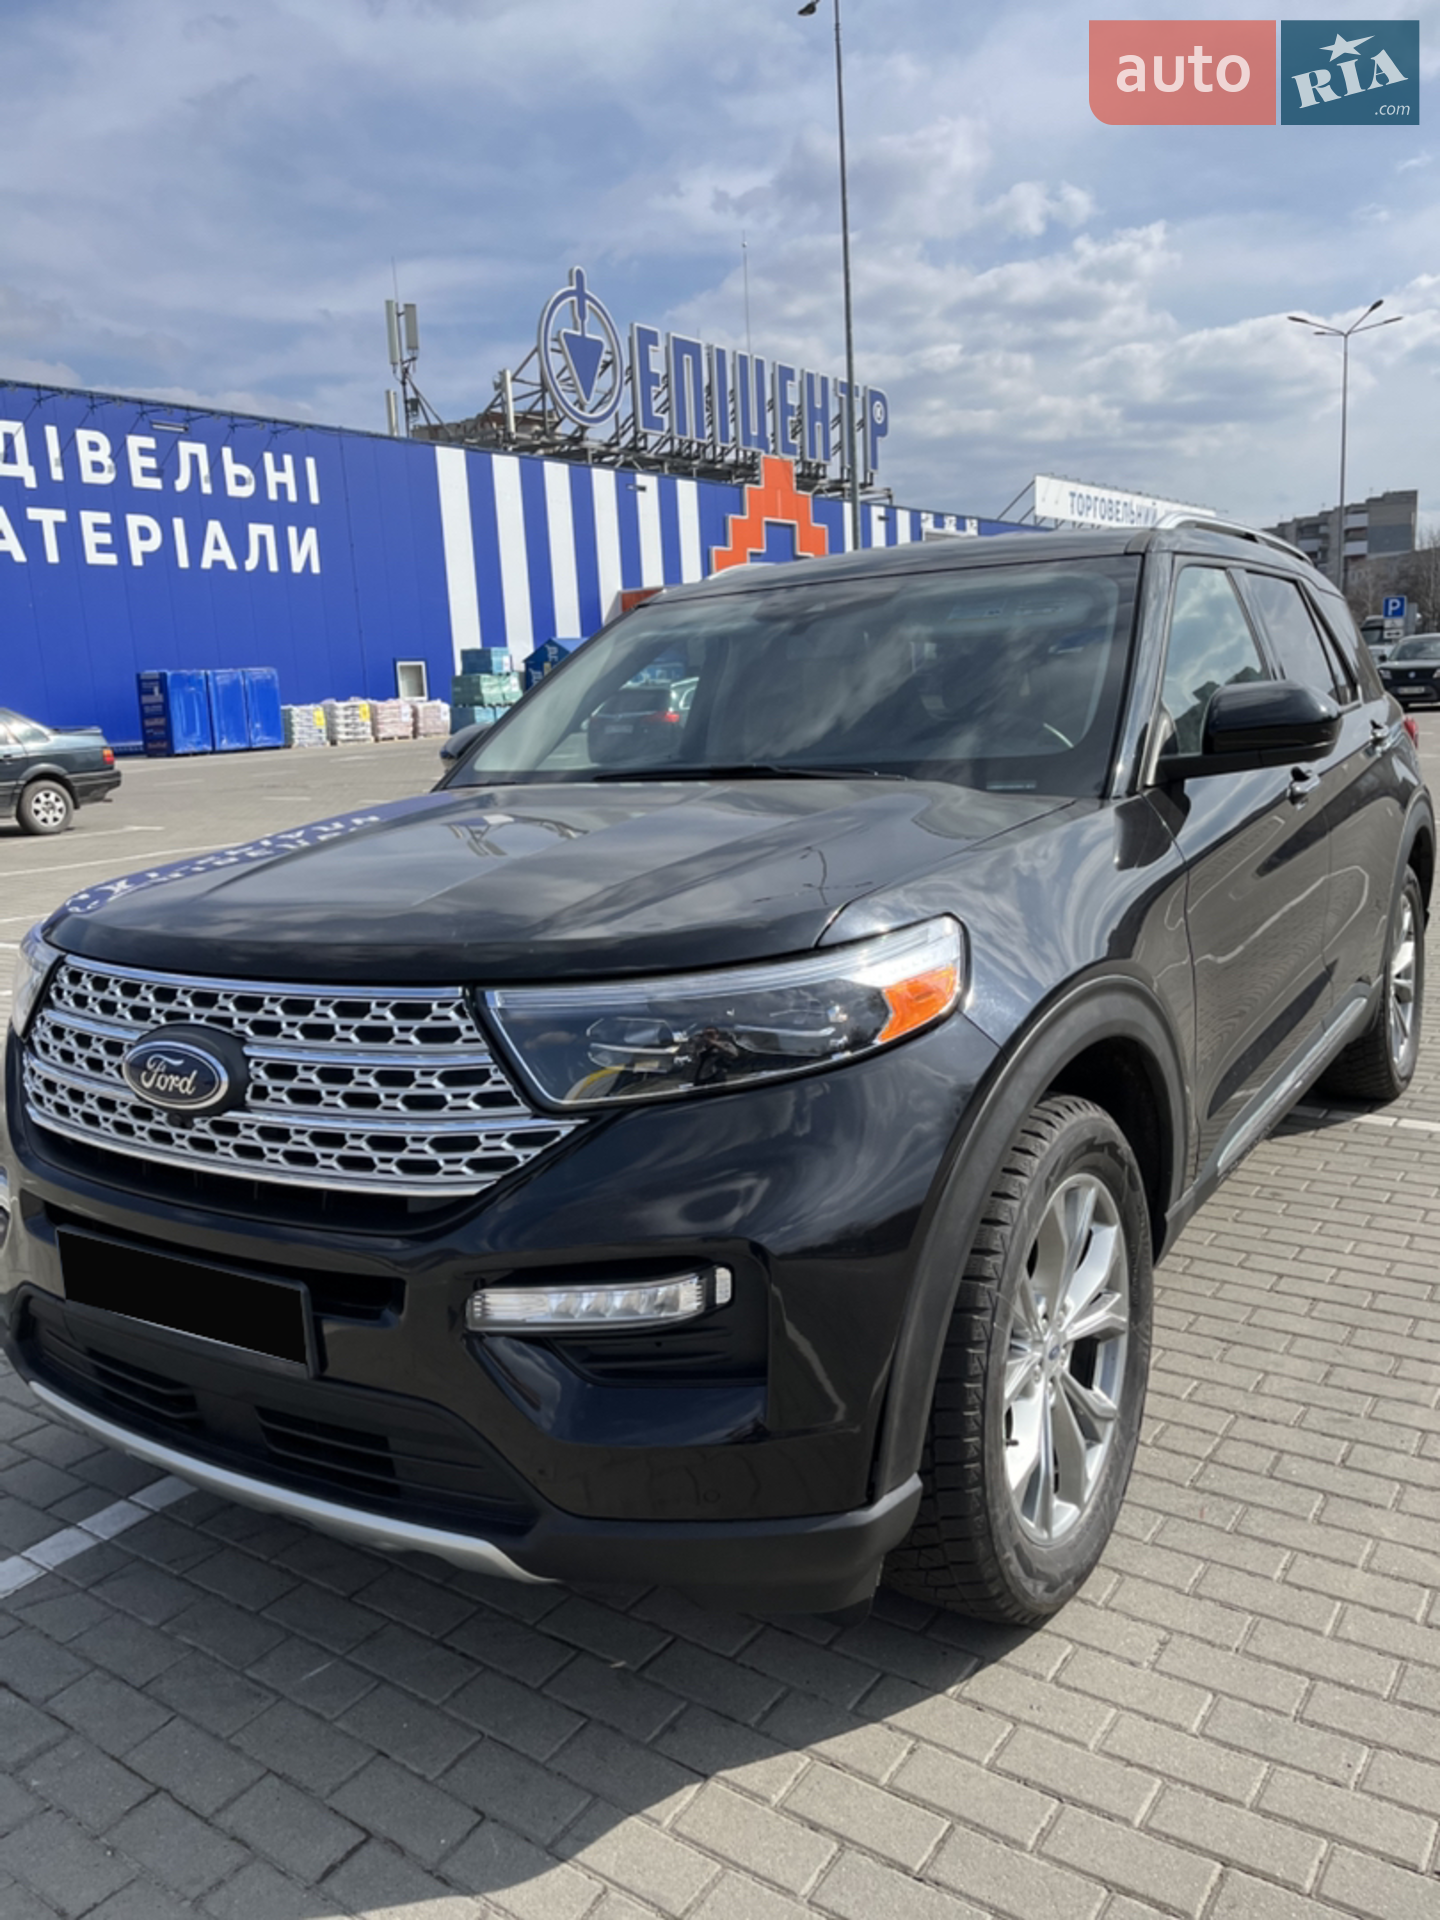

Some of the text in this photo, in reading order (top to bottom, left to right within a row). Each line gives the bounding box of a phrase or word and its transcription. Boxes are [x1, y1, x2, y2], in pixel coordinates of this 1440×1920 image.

[630, 321, 889, 474] ЕПІЦЕНТР
[1387, 598, 1401, 616] P
[140, 1053, 198, 1096] Ford
